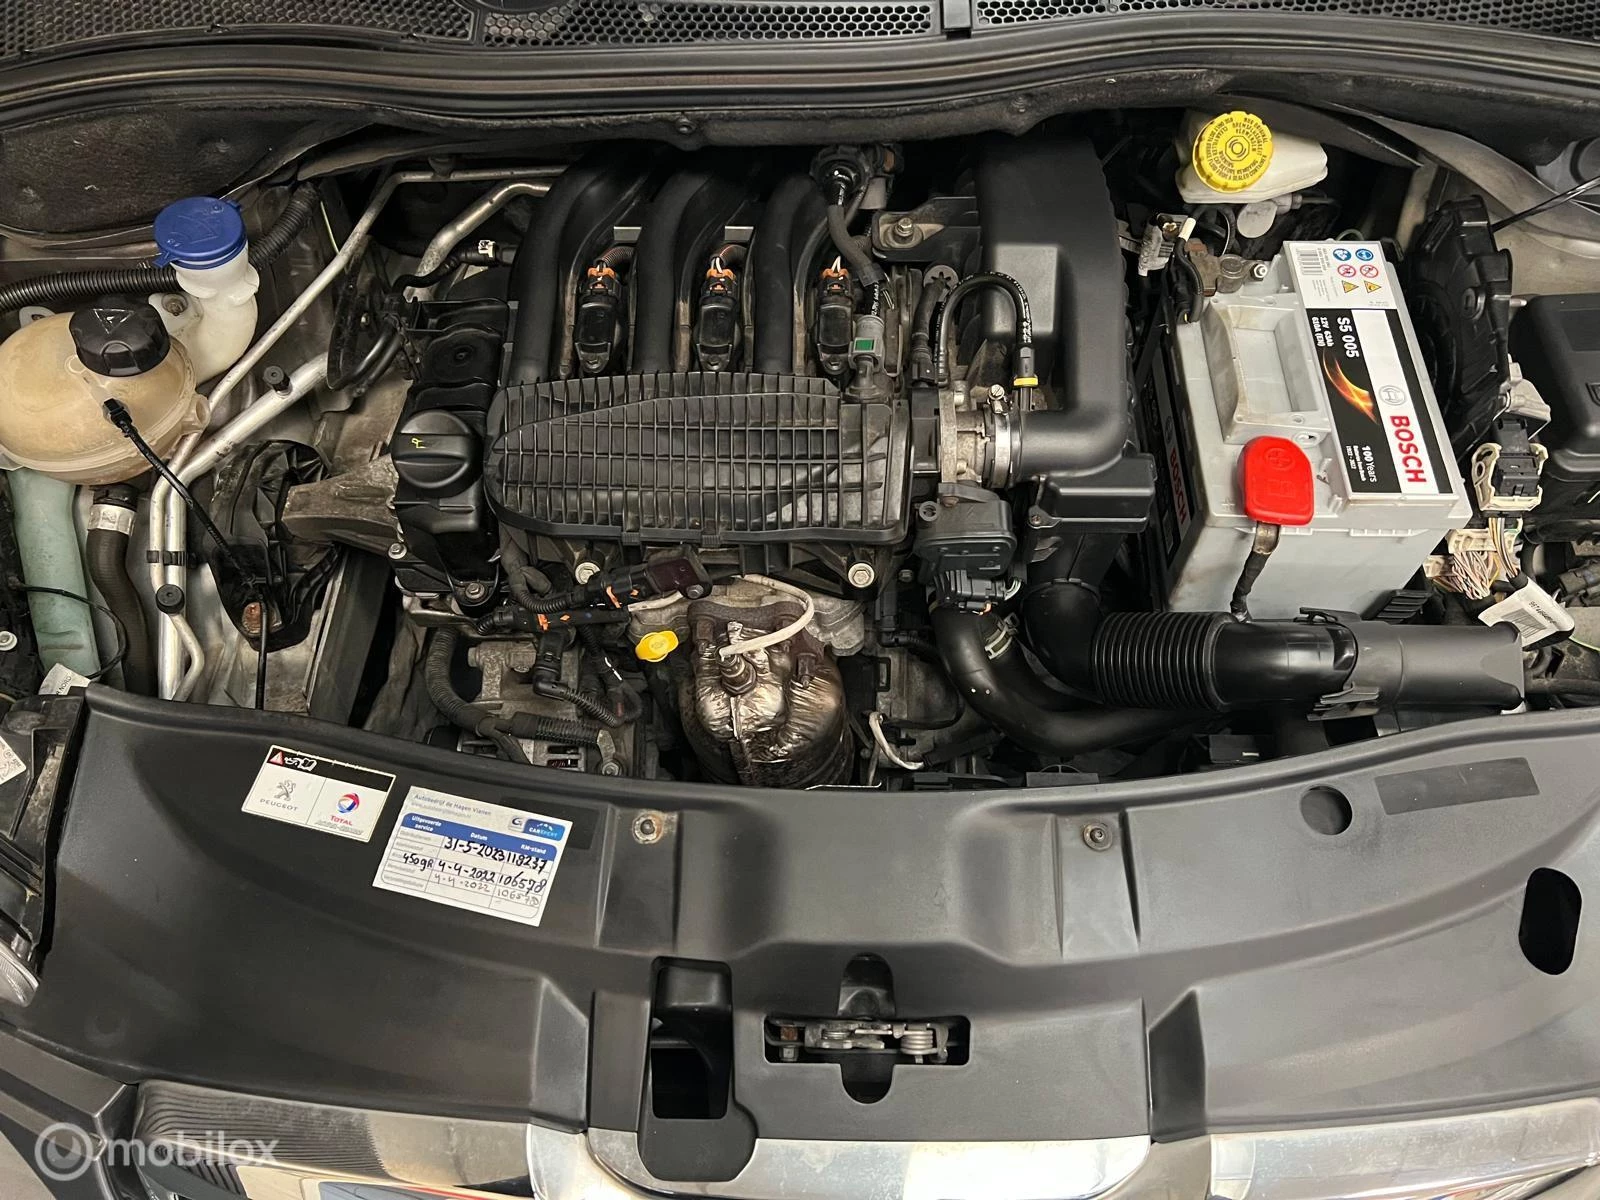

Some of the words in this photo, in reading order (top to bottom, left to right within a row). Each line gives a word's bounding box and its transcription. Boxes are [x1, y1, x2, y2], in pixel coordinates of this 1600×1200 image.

[1337, 317, 1352, 332] S5
[1342, 335, 1360, 358] 005
[1362, 445, 1373, 462] 100
[1390, 415, 1427, 482] BOSCH
[1366, 462, 1377, 483] Years
[1170, 447, 1187, 525] BOSCH
[260, 798, 298, 811] PEUGEOT
[330, 815, 353, 826] TOTAL
[438, 860, 495, 883] 4-4-2022
[499, 871, 547, 894] 106578
